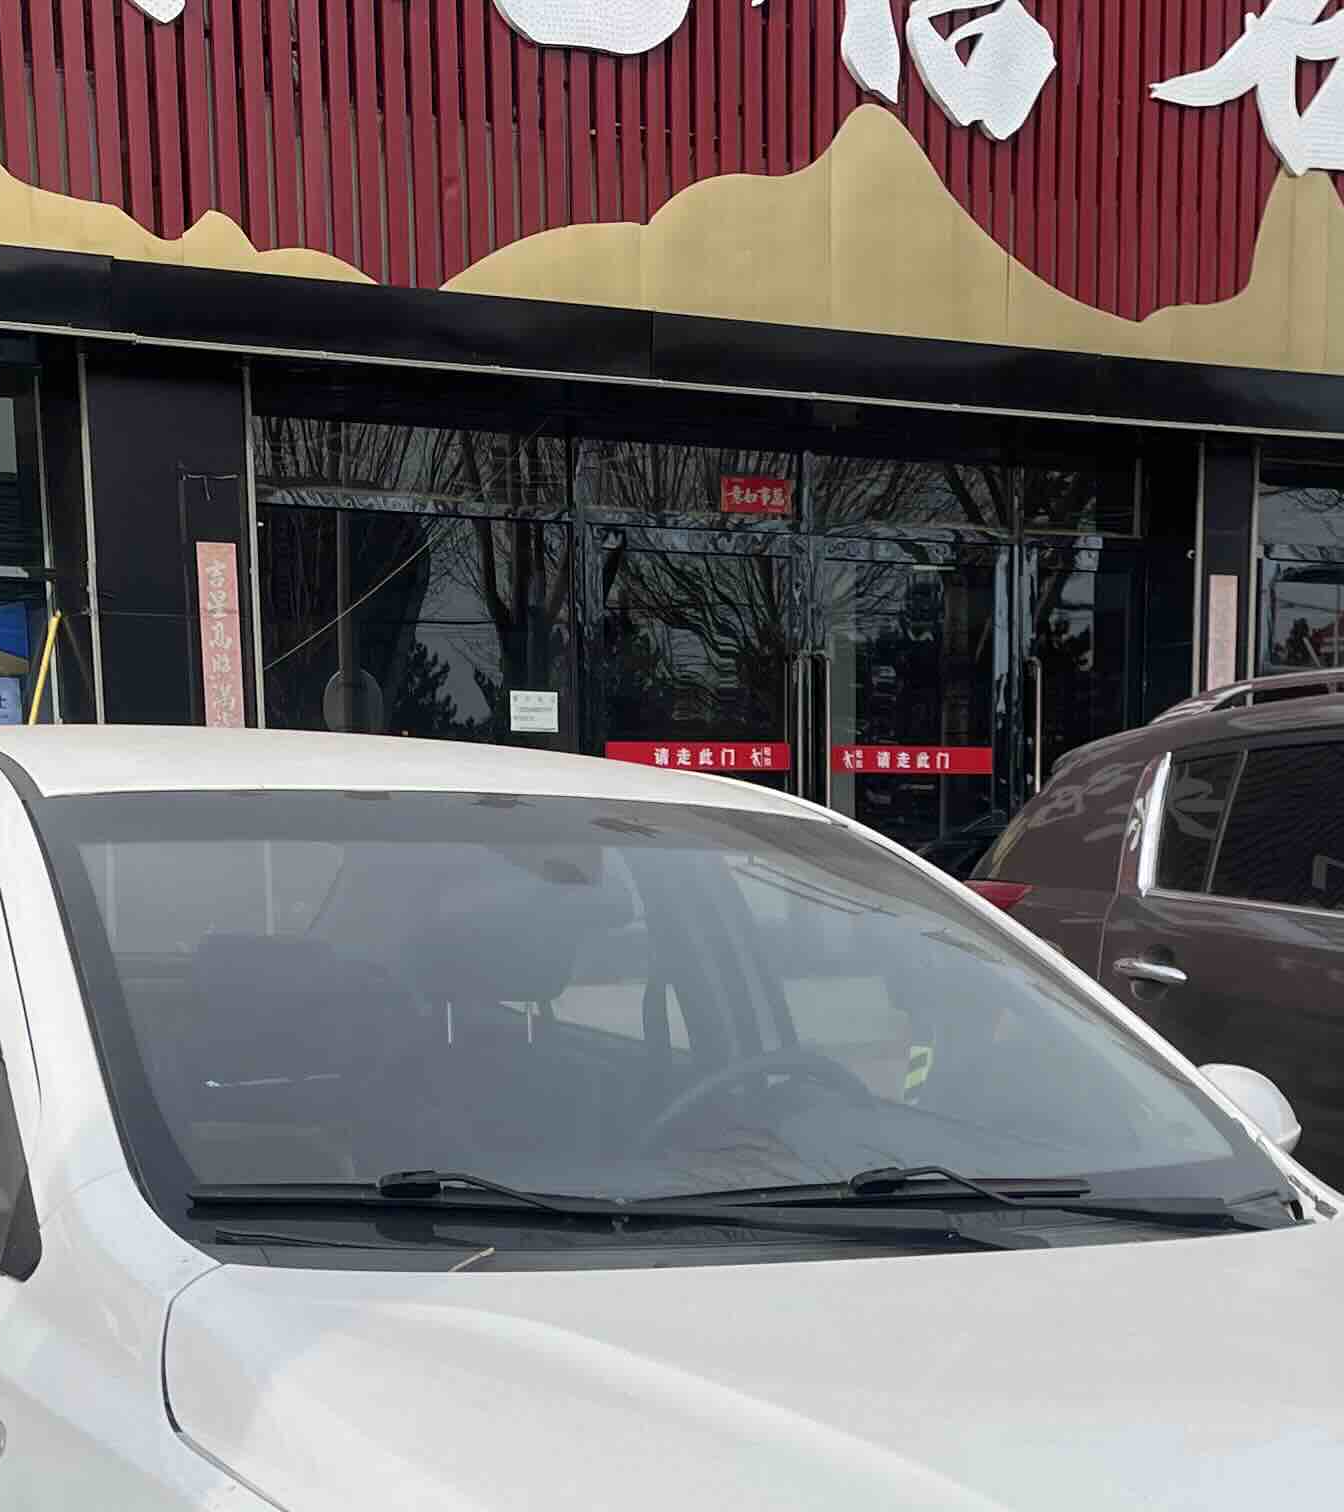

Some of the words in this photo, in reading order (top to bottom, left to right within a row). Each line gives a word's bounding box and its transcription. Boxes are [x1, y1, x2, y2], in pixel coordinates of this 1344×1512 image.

[654, 747, 736, 766] 请走此门
[877, 751, 950, 769] 请走此门
